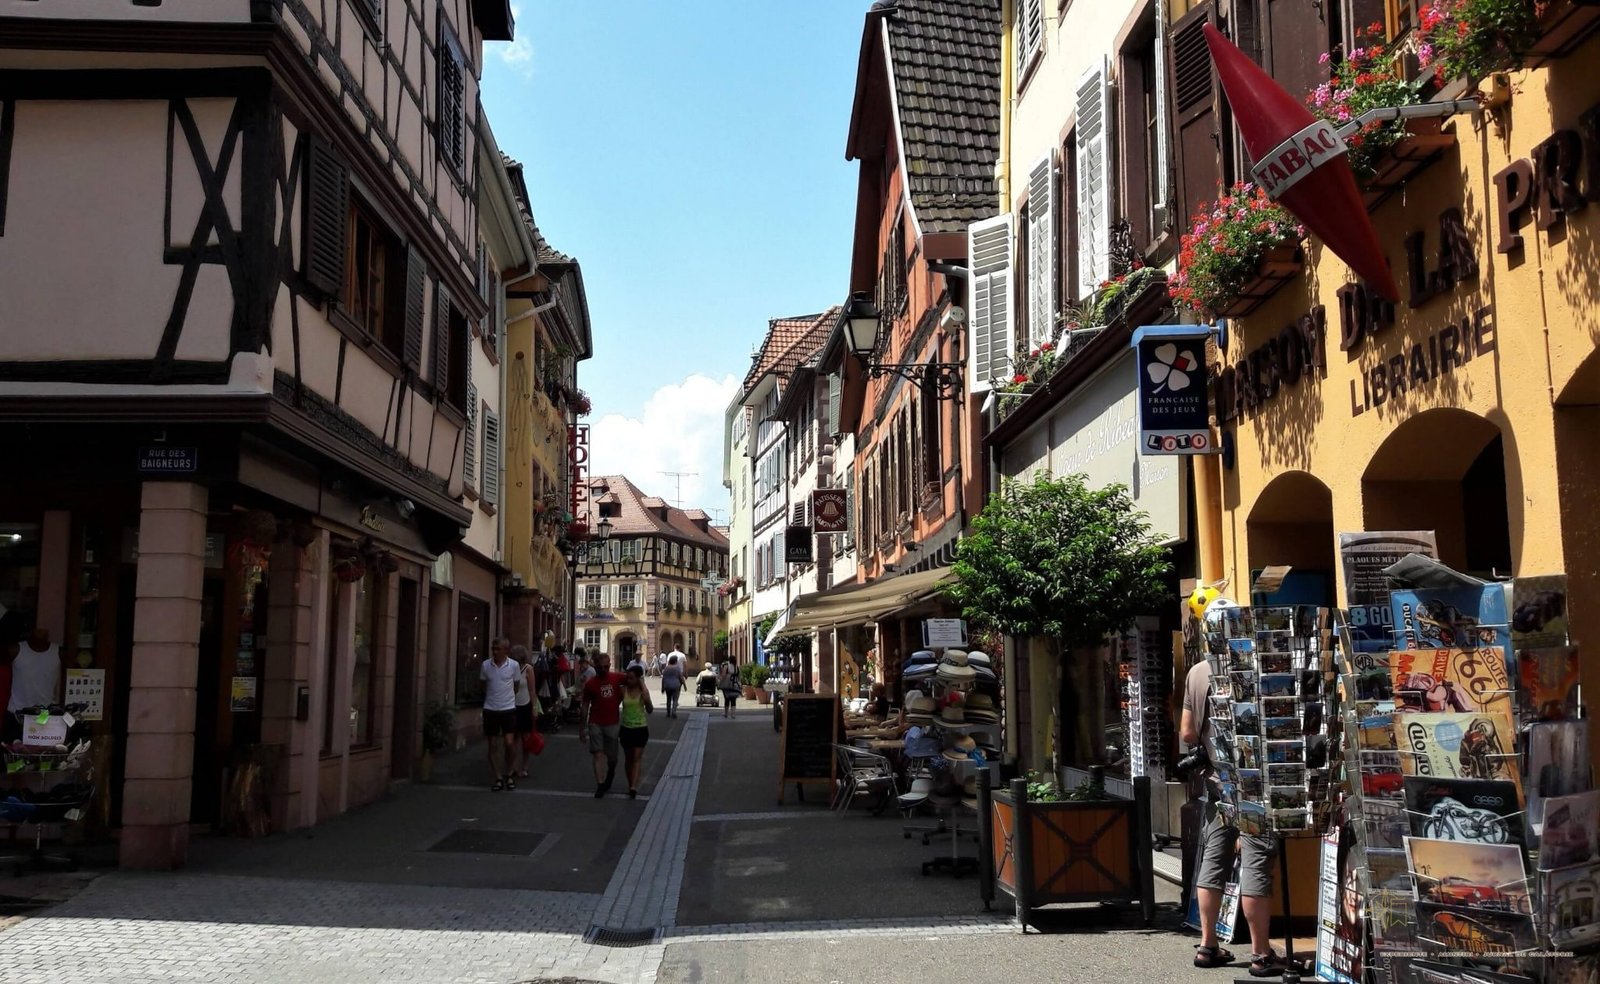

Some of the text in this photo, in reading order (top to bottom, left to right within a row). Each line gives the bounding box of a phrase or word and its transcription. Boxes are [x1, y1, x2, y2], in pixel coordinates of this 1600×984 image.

[1253, 124, 1341, 192] TABAC
[1405, 206, 1481, 309] LA
[1349, 304, 1497, 418] LIBRAIRIE
[1152, 406, 1197, 414] DES JEUX
[148, 450, 186, 458] RUE DES
[1147, 433, 1207, 452] LOTO
[141, 459, 191, 469] BAIGNEURS
[567, 426, 588, 523] HOTEL
[790, 547, 807, 555] GAYA
[1346, 556, 1380, 564] PLAQUES
[1401, 604, 1416, 642] DUCATI
[1433, 649, 1449, 682] DRIVE
[1459, 659, 1493, 696] 66
[1481, 648, 1508, 685] ROUTE
